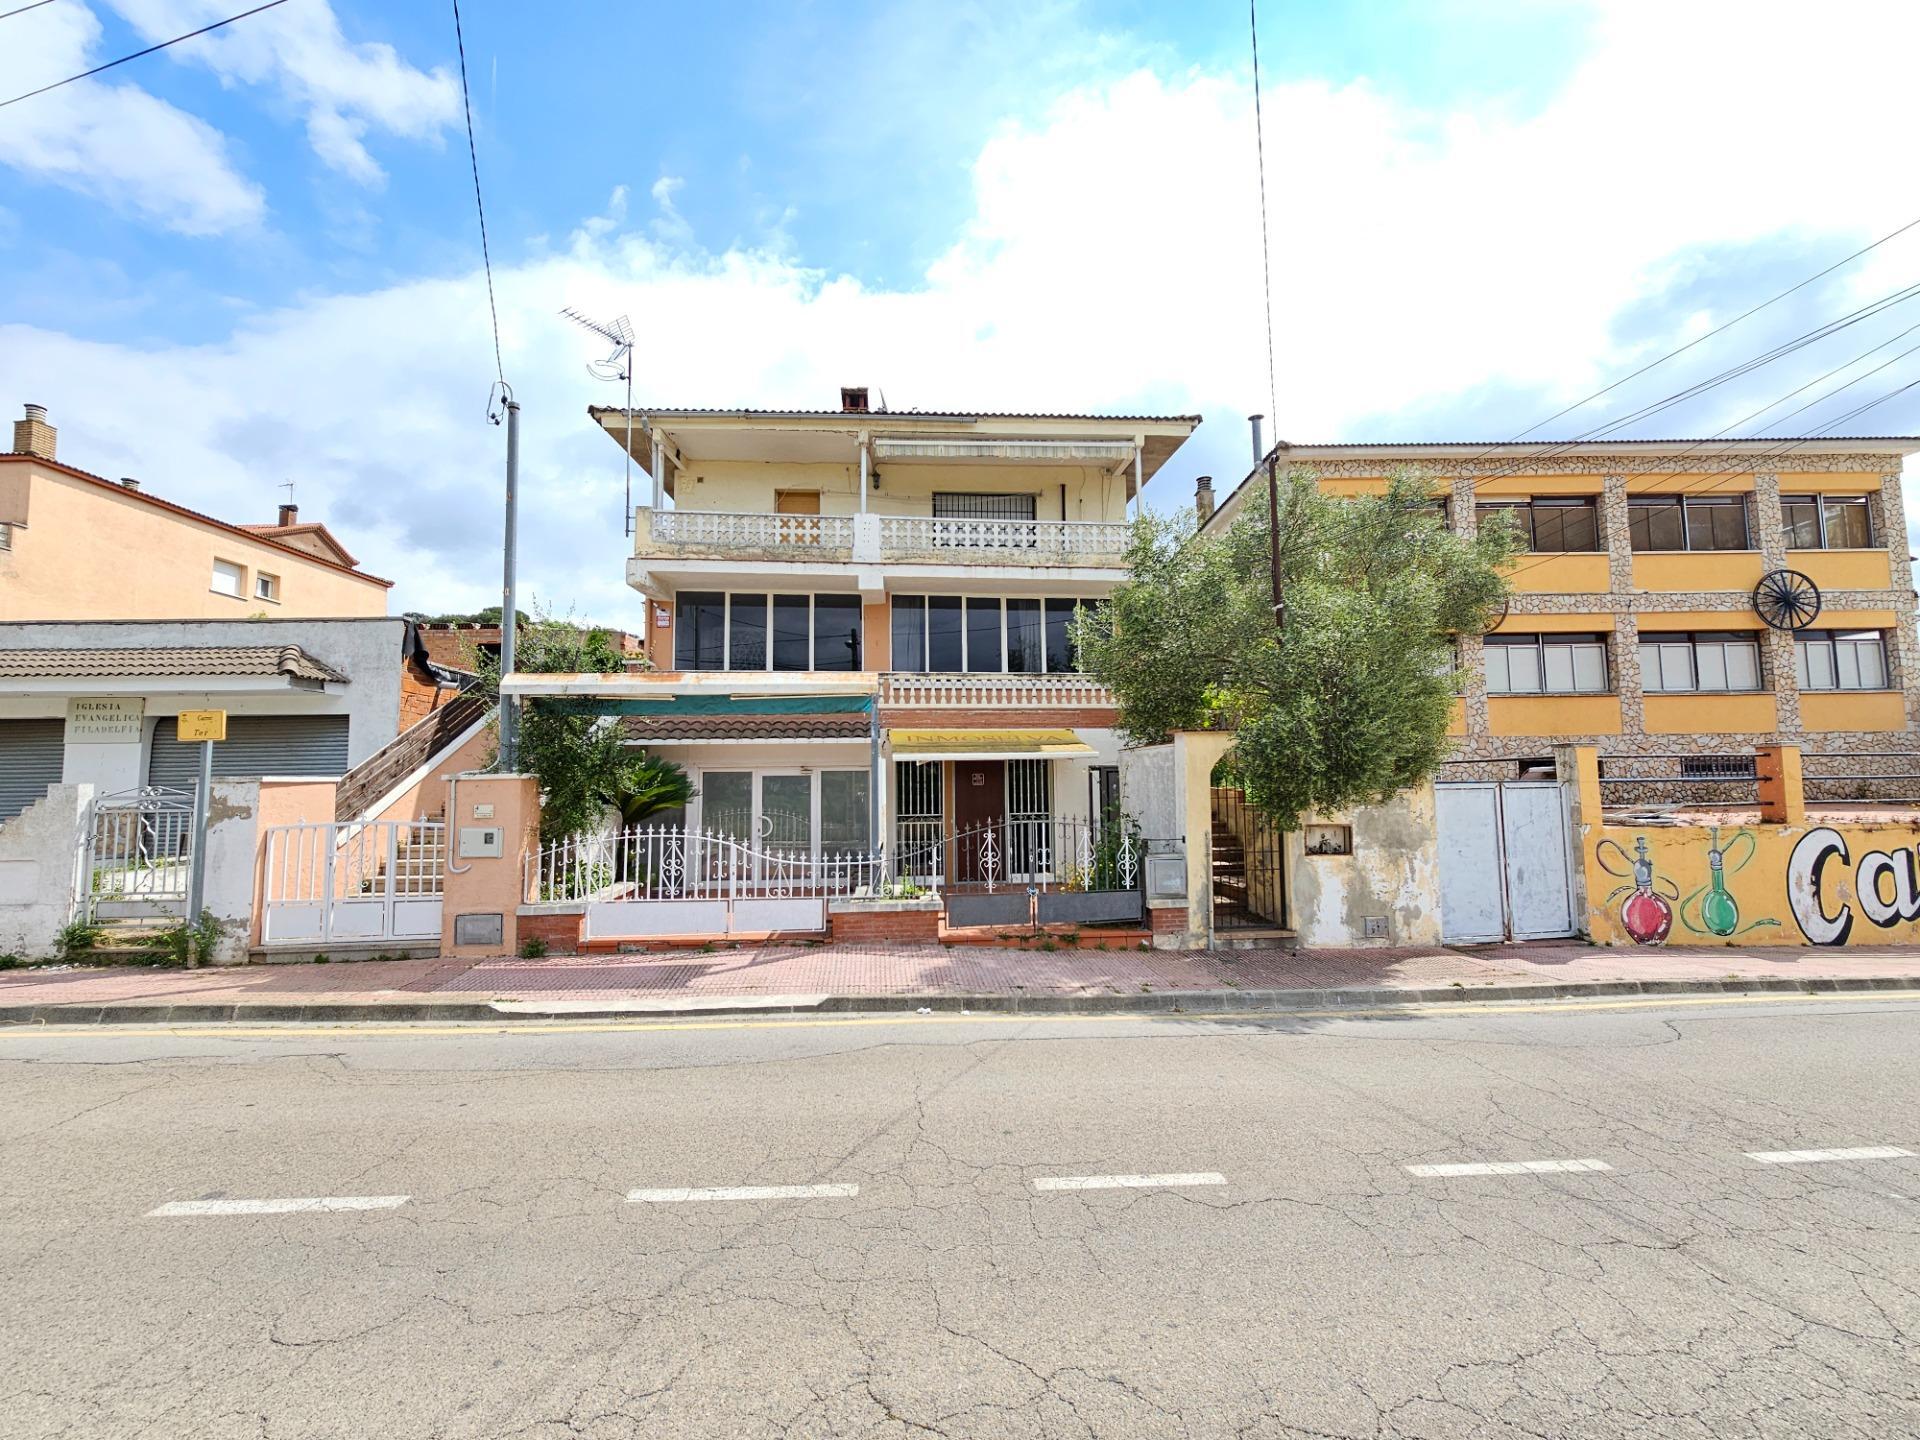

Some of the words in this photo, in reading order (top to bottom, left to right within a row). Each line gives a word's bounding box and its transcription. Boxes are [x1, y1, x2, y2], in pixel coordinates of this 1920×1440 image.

[76, 703, 121, 711] IGLESIA
[74, 714, 140, 722] EVANGELICA
[1786, 826, 1920, 947] Ca
